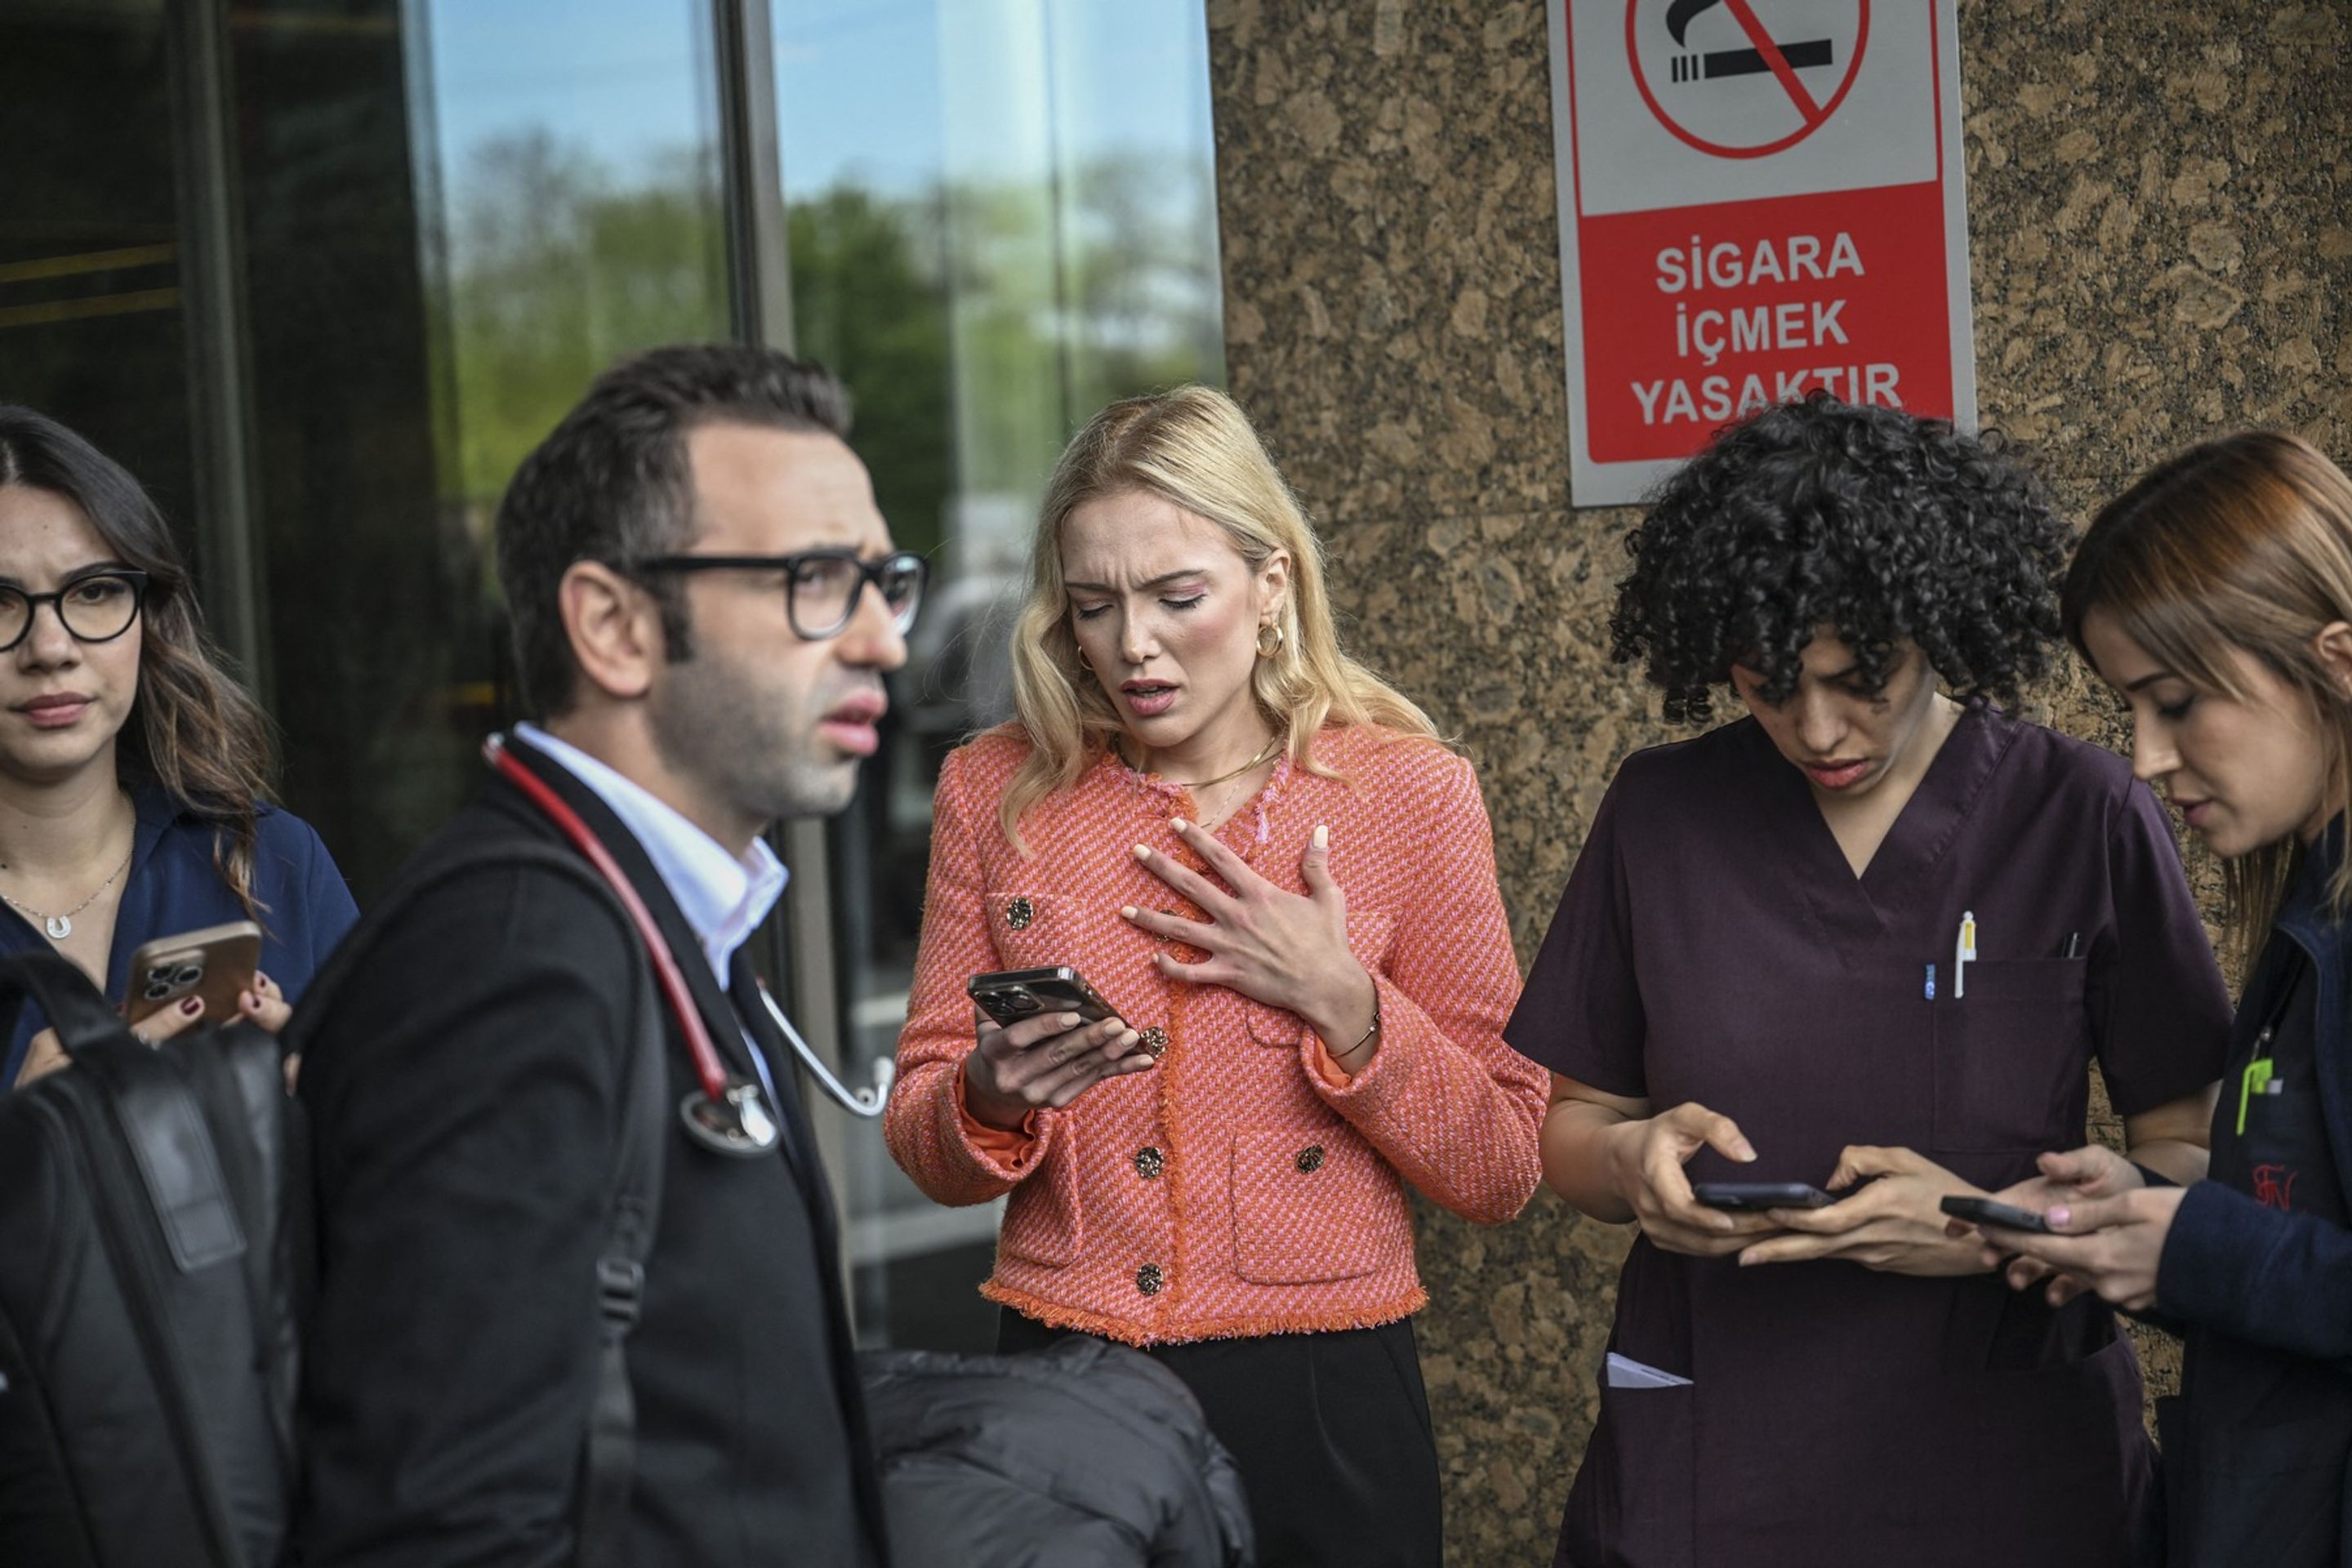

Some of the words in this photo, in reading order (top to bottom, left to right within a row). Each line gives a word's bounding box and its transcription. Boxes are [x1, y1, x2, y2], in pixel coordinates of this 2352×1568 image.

[1656, 233, 1865, 293] SİGARA
[1676, 300, 1849, 366] İÇMEK
[1631, 363, 1903, 425] YASAKTIR
